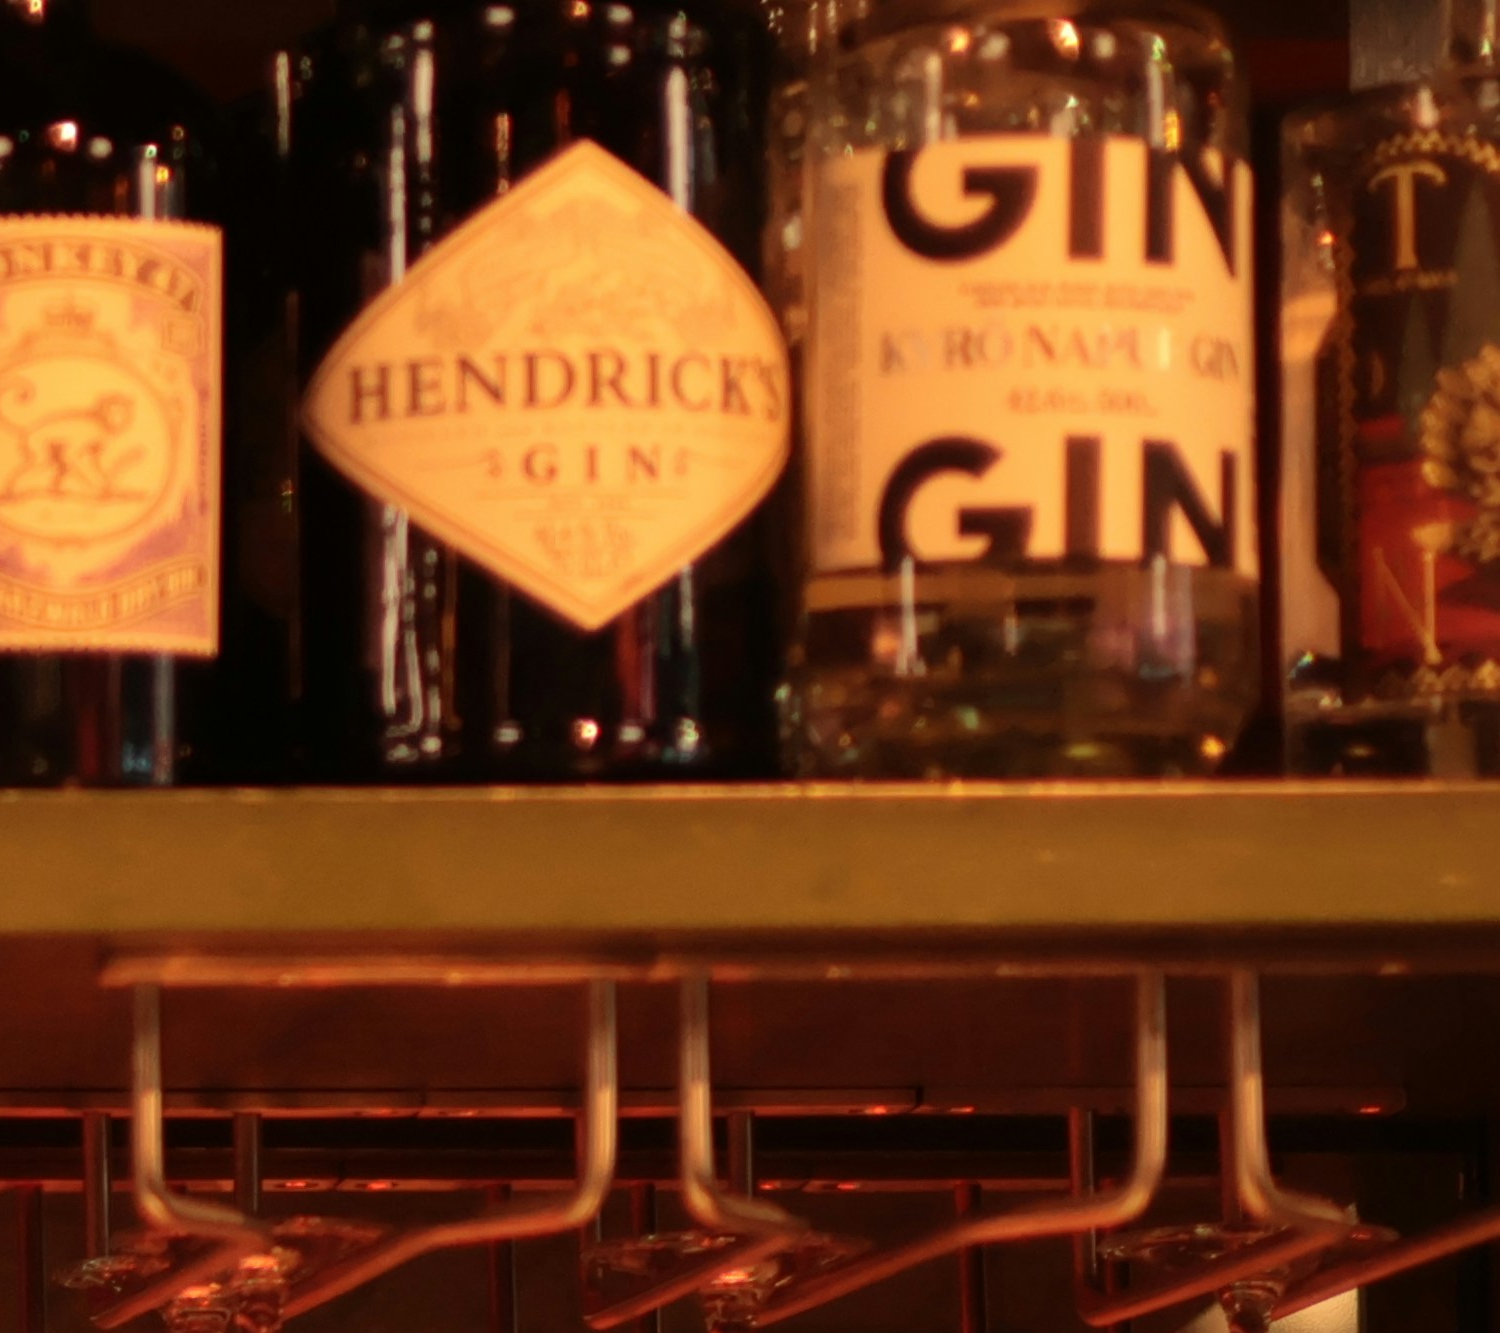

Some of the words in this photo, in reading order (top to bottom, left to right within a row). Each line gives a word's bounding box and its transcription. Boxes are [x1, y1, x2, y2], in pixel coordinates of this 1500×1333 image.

[882, 135, 1240, 283] GIN
[520, 442, 663, 488] GIN
[877, 434, 1239, 573] GIN
